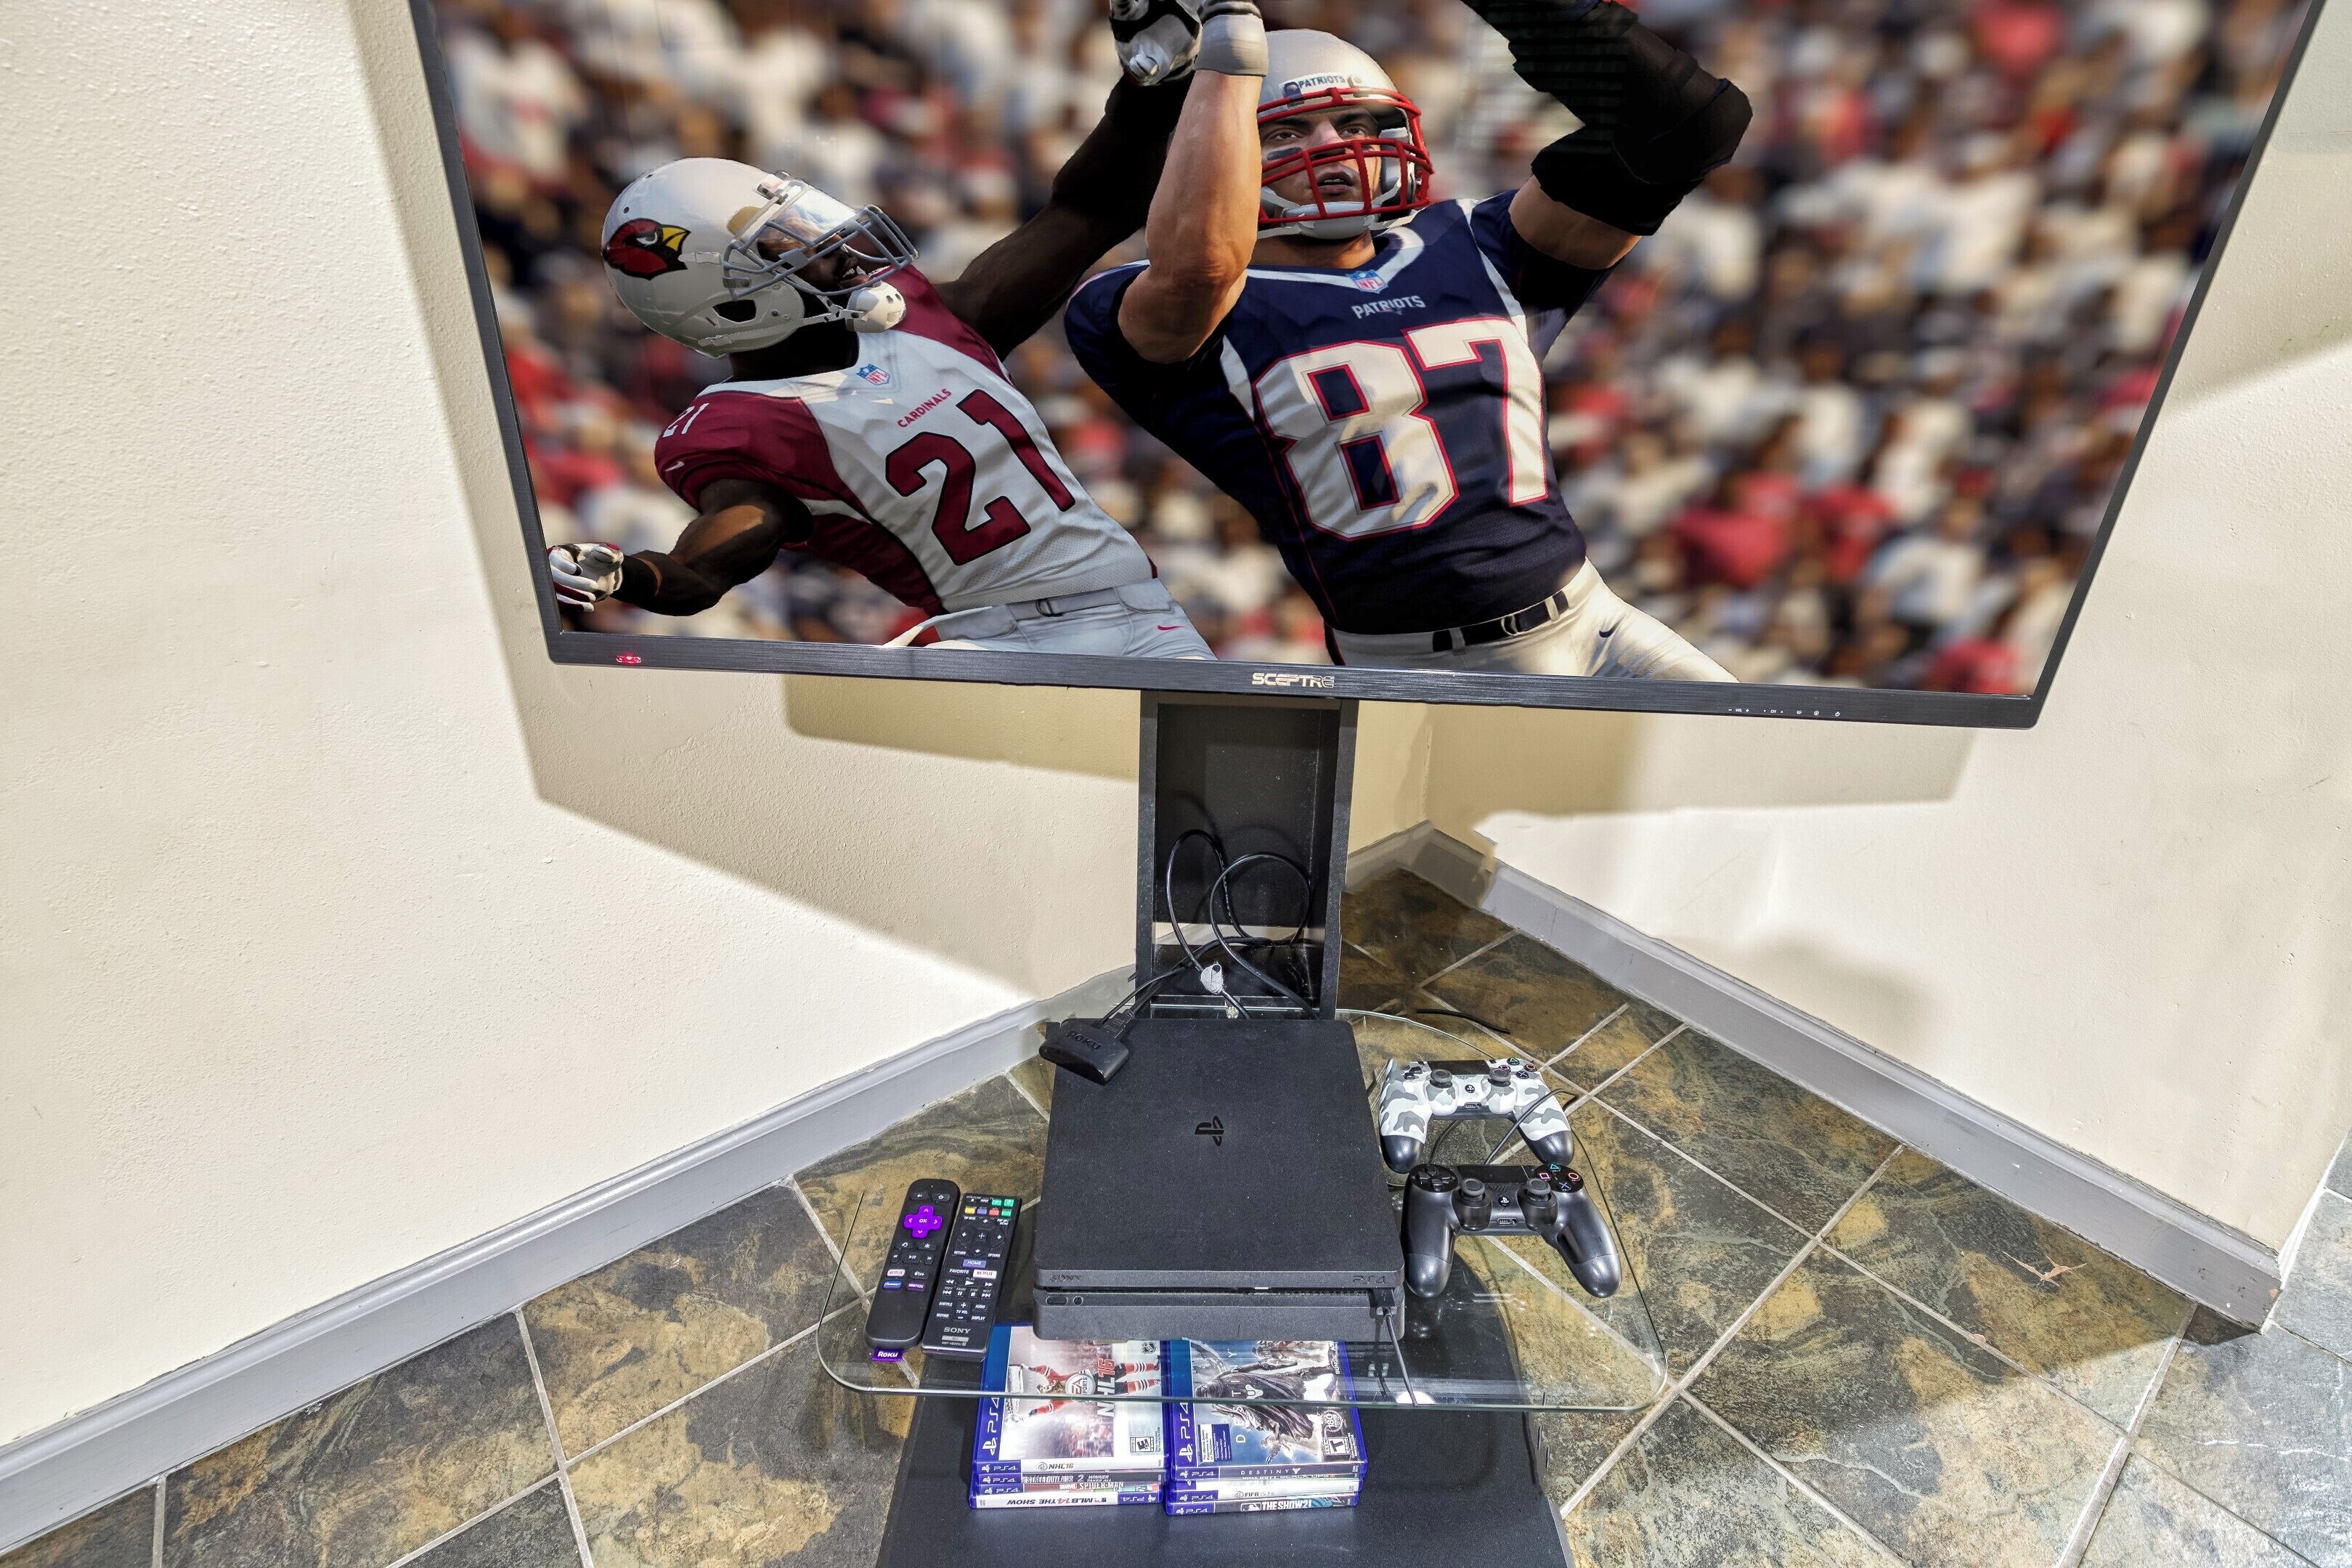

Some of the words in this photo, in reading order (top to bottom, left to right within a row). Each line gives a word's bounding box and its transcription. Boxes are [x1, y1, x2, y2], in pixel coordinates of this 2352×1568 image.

[1298, 75, 1346, 88] PATRIOTS
[1351, 295, 1426, 319] PATRIOTS
[662, 402, 710, 438] 21
[897, 388, 952, 428] CARDINALS
[1252, 316, 1549, 542] 87
[884, 388, 1076, 566] 21
[1251, 672, 1335, 688] SCEPTRE
[1352, 1275, 1385, 1284] PS4
[988, 1397, 1000, 1433] PS4
[1179, 1402, 1191, 1440] PS4
[1330, 1440, 1344, 1452] T
[1077, 1474, 1085, 1482] 2
[1079, 1482, 1124, 1490] SPIDER-MAN
